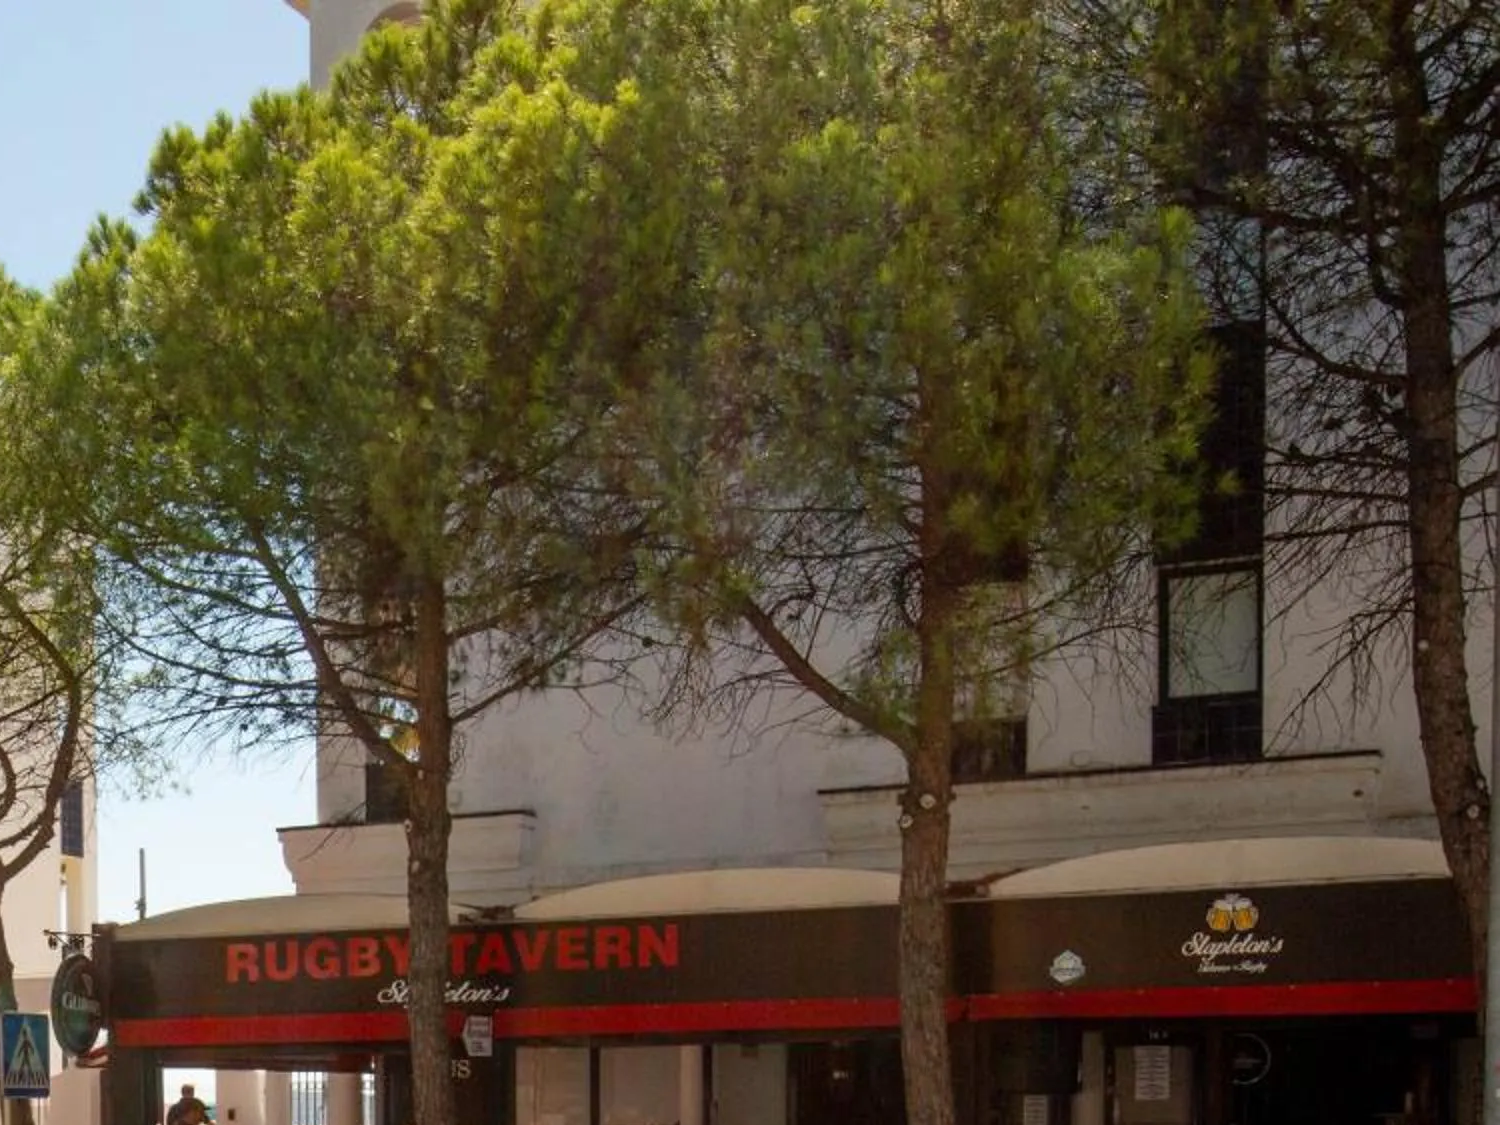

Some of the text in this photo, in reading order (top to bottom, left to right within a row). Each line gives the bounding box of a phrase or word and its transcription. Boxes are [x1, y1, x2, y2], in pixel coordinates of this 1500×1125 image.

[225, 922, 679, 985] RUGBY TAVERN
[377, 979, 511, 1008] Steton's
